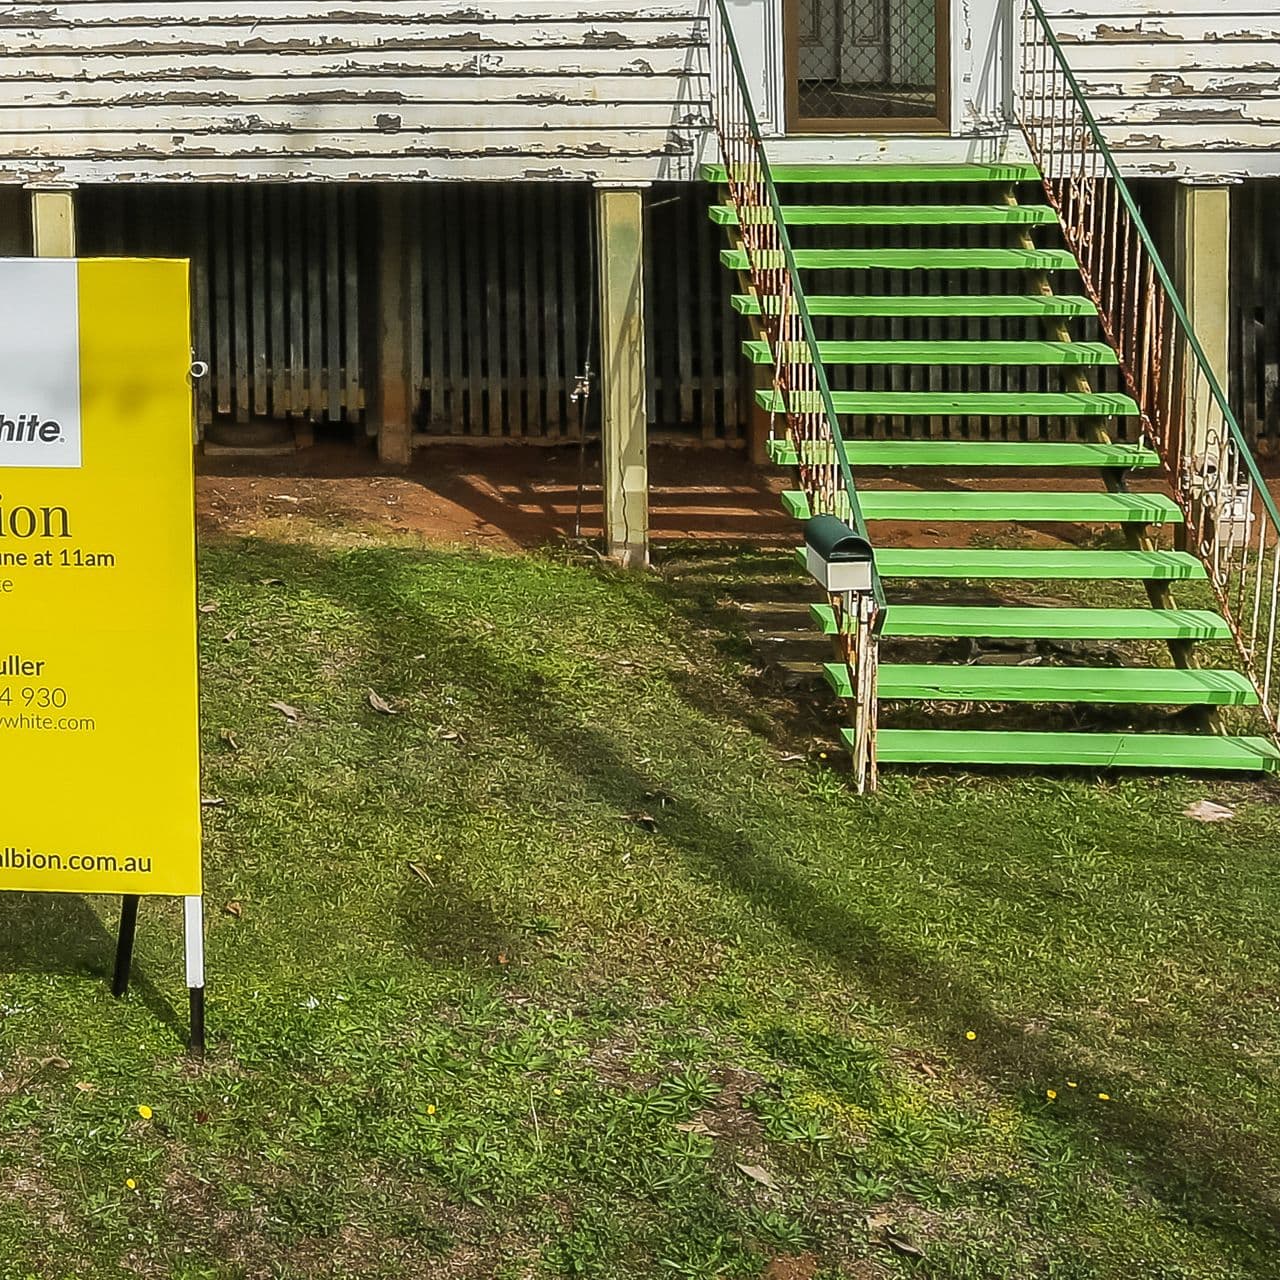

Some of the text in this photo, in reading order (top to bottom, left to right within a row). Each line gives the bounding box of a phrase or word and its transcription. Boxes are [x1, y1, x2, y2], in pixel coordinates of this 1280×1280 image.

[33, 550, 53, 566] at
[60, 549, 115, 567] 11am
[22, 687, 67, 708] 930
